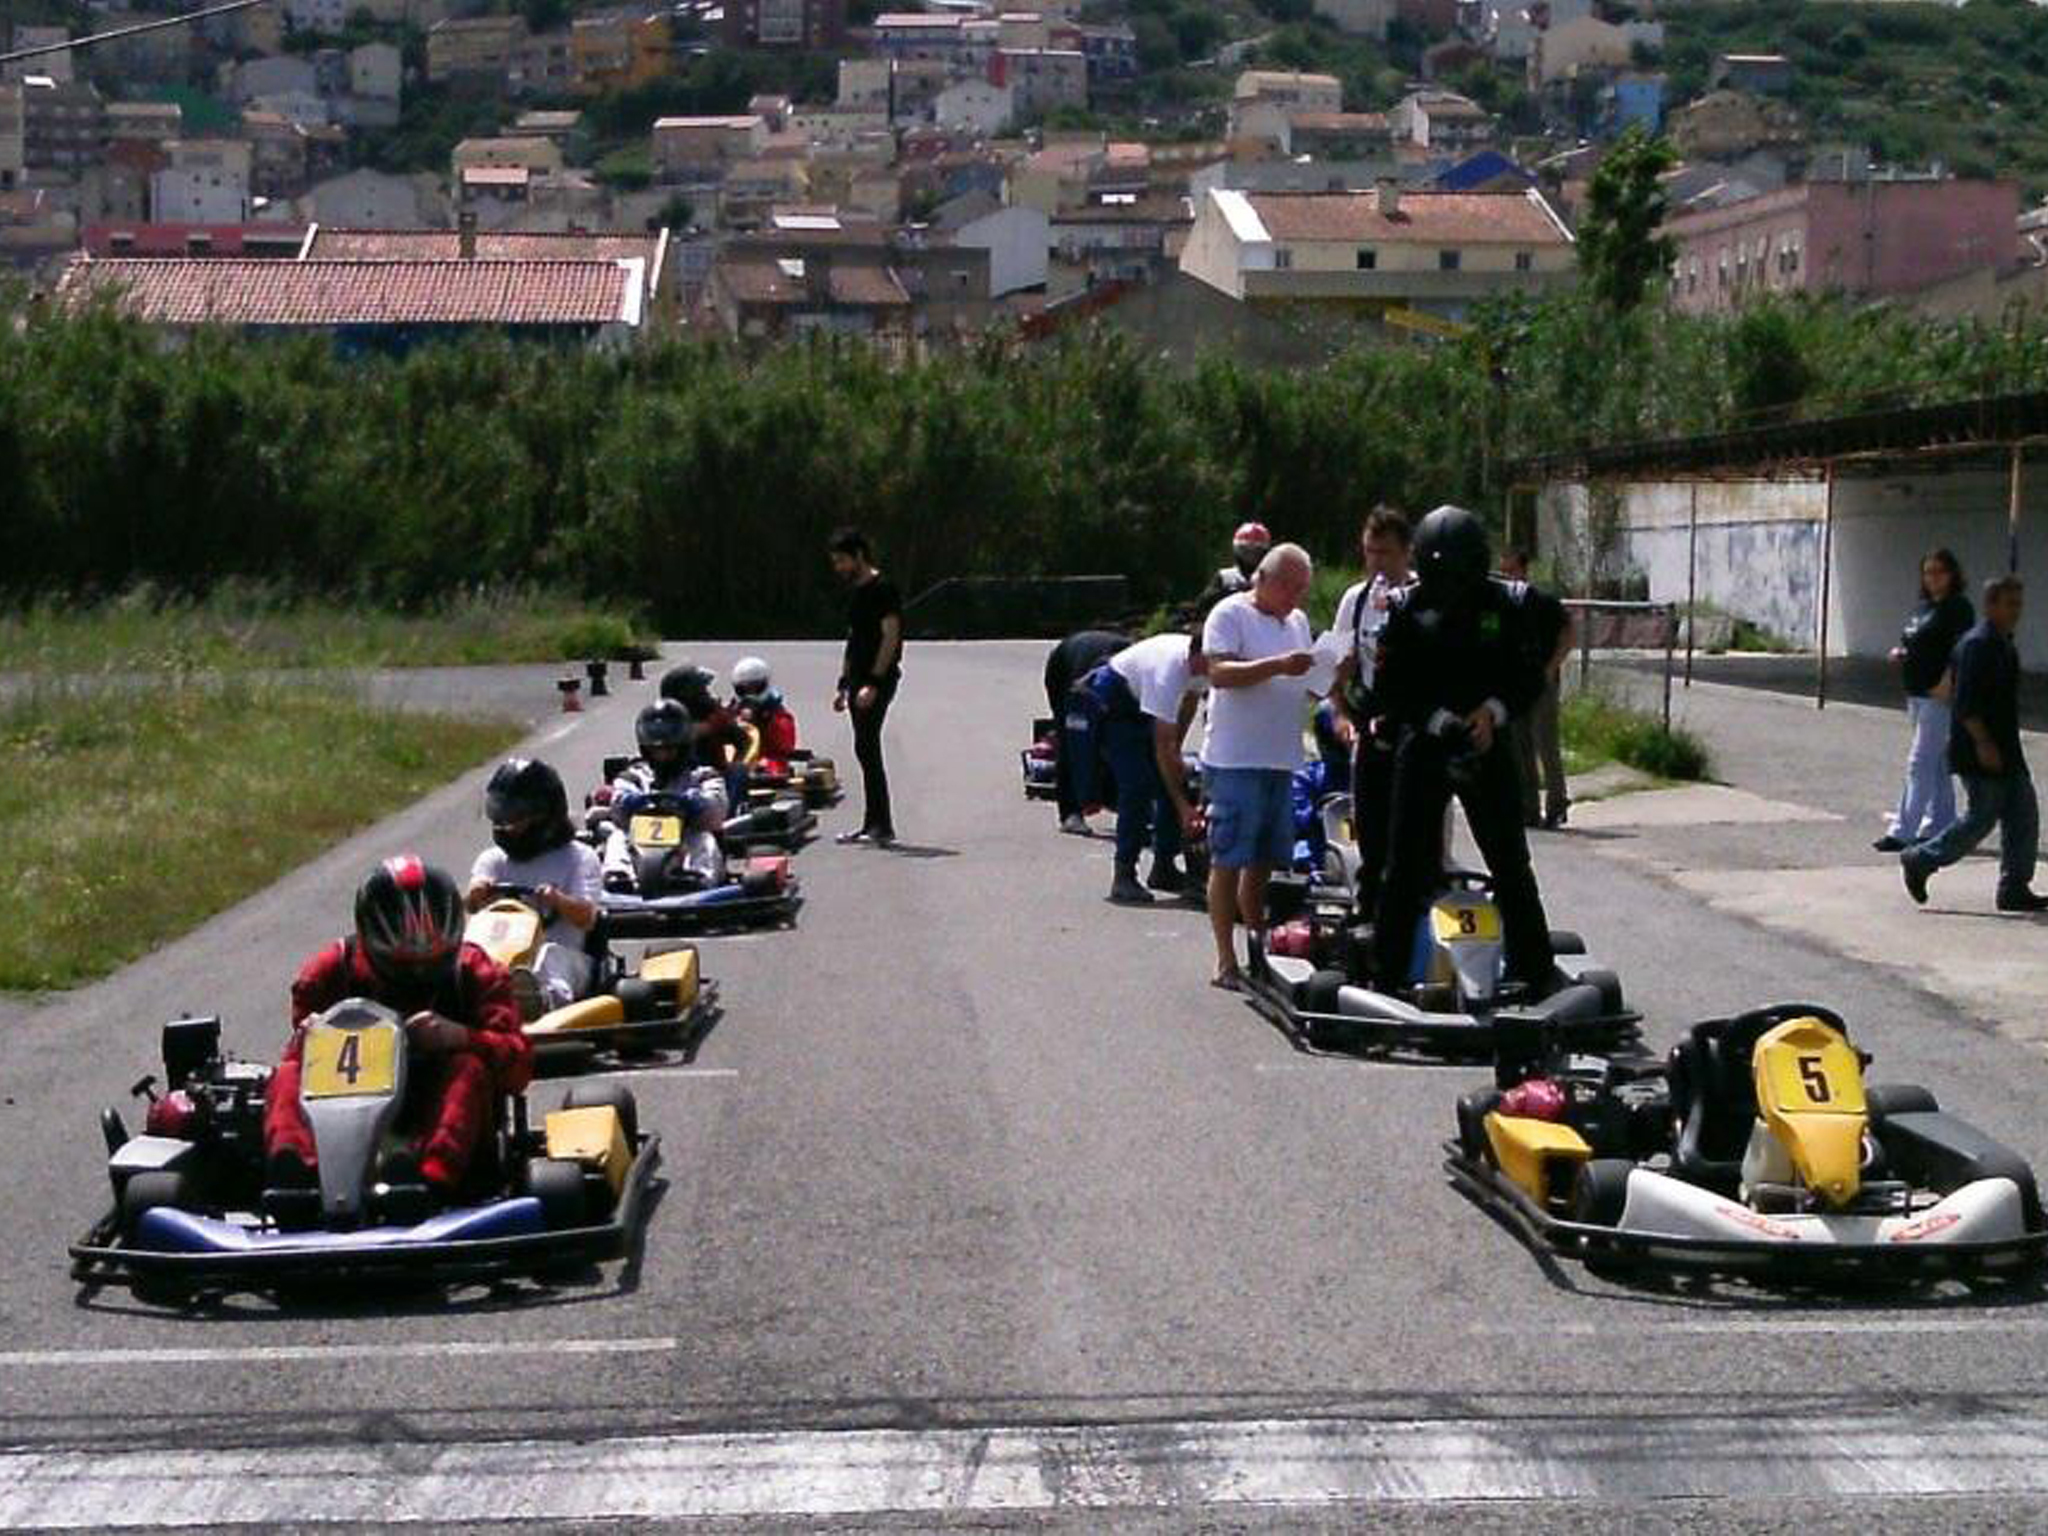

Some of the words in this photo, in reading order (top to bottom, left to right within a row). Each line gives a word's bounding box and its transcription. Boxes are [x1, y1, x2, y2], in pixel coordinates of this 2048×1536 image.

[650, 820, 663, 840] 2
[491, 920, 509, 941] 9
[1459, 909, 1476, 934] 3
[337, 1035, 360, 1084] 4
[1798, 1057, 1831, 1103] 5
